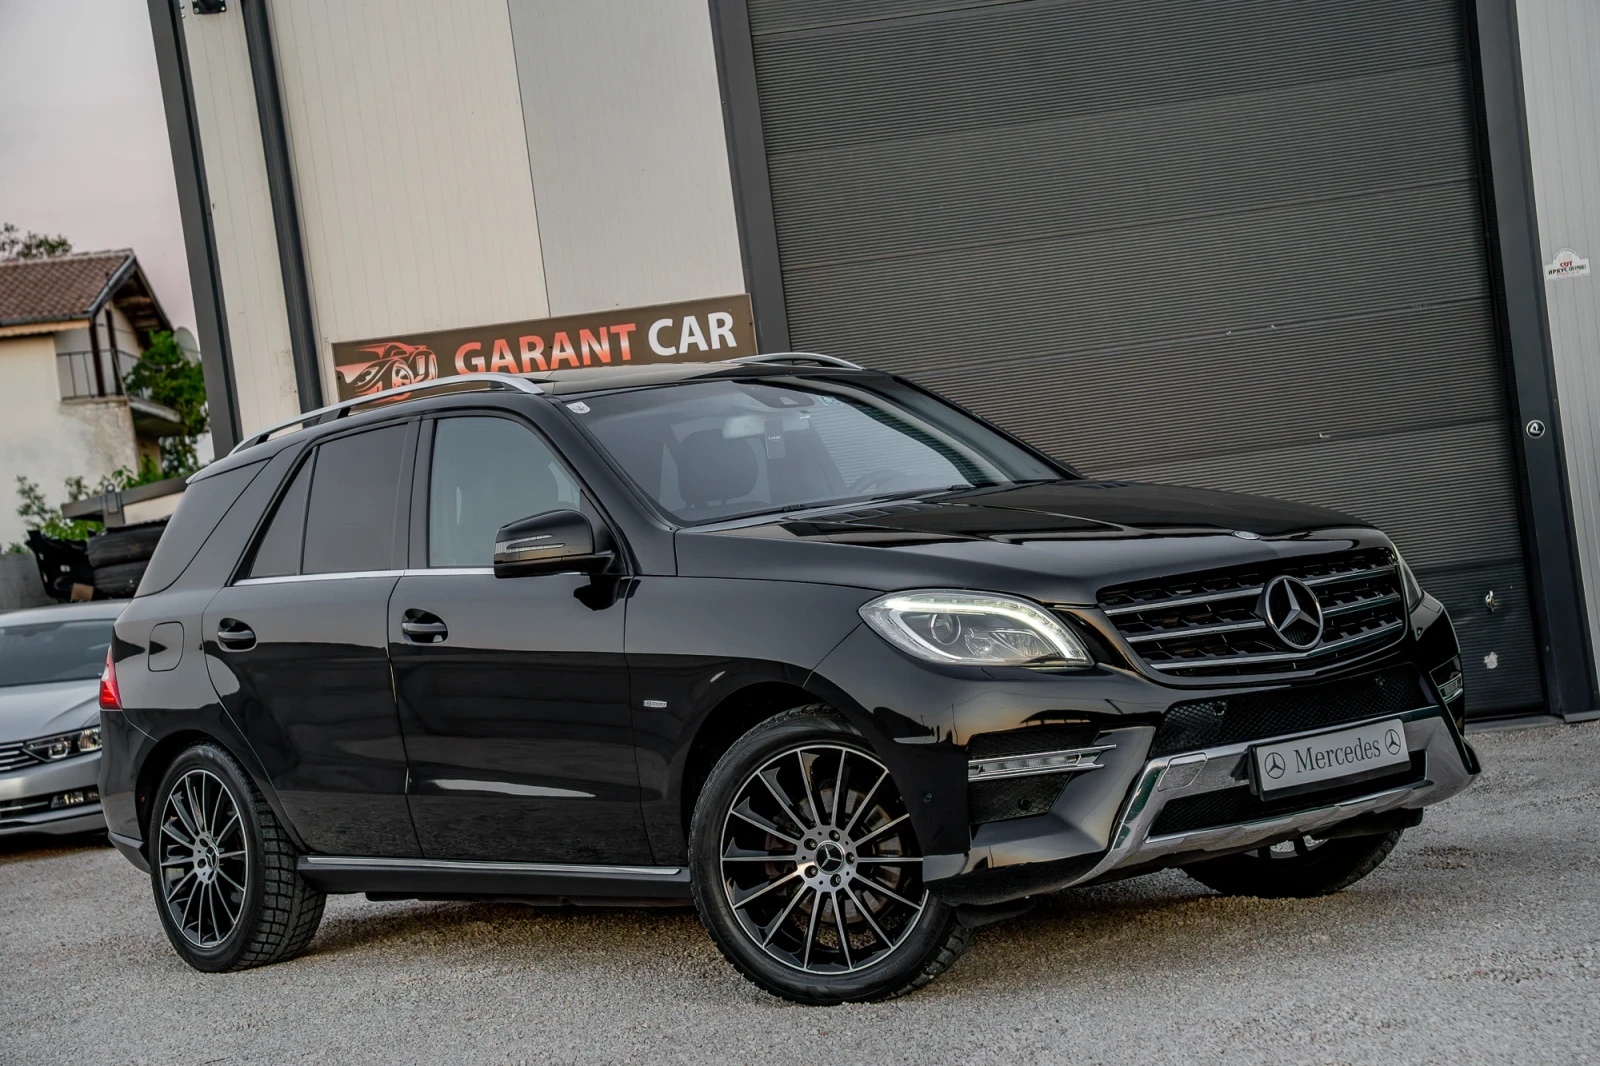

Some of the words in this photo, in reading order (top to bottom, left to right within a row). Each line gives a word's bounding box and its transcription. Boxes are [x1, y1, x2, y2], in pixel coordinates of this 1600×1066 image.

[454, 323, 636, 375] GARANT
[648, 311, 738, 356] CAR
[1293, 737, 1381, 774] Mercedes
